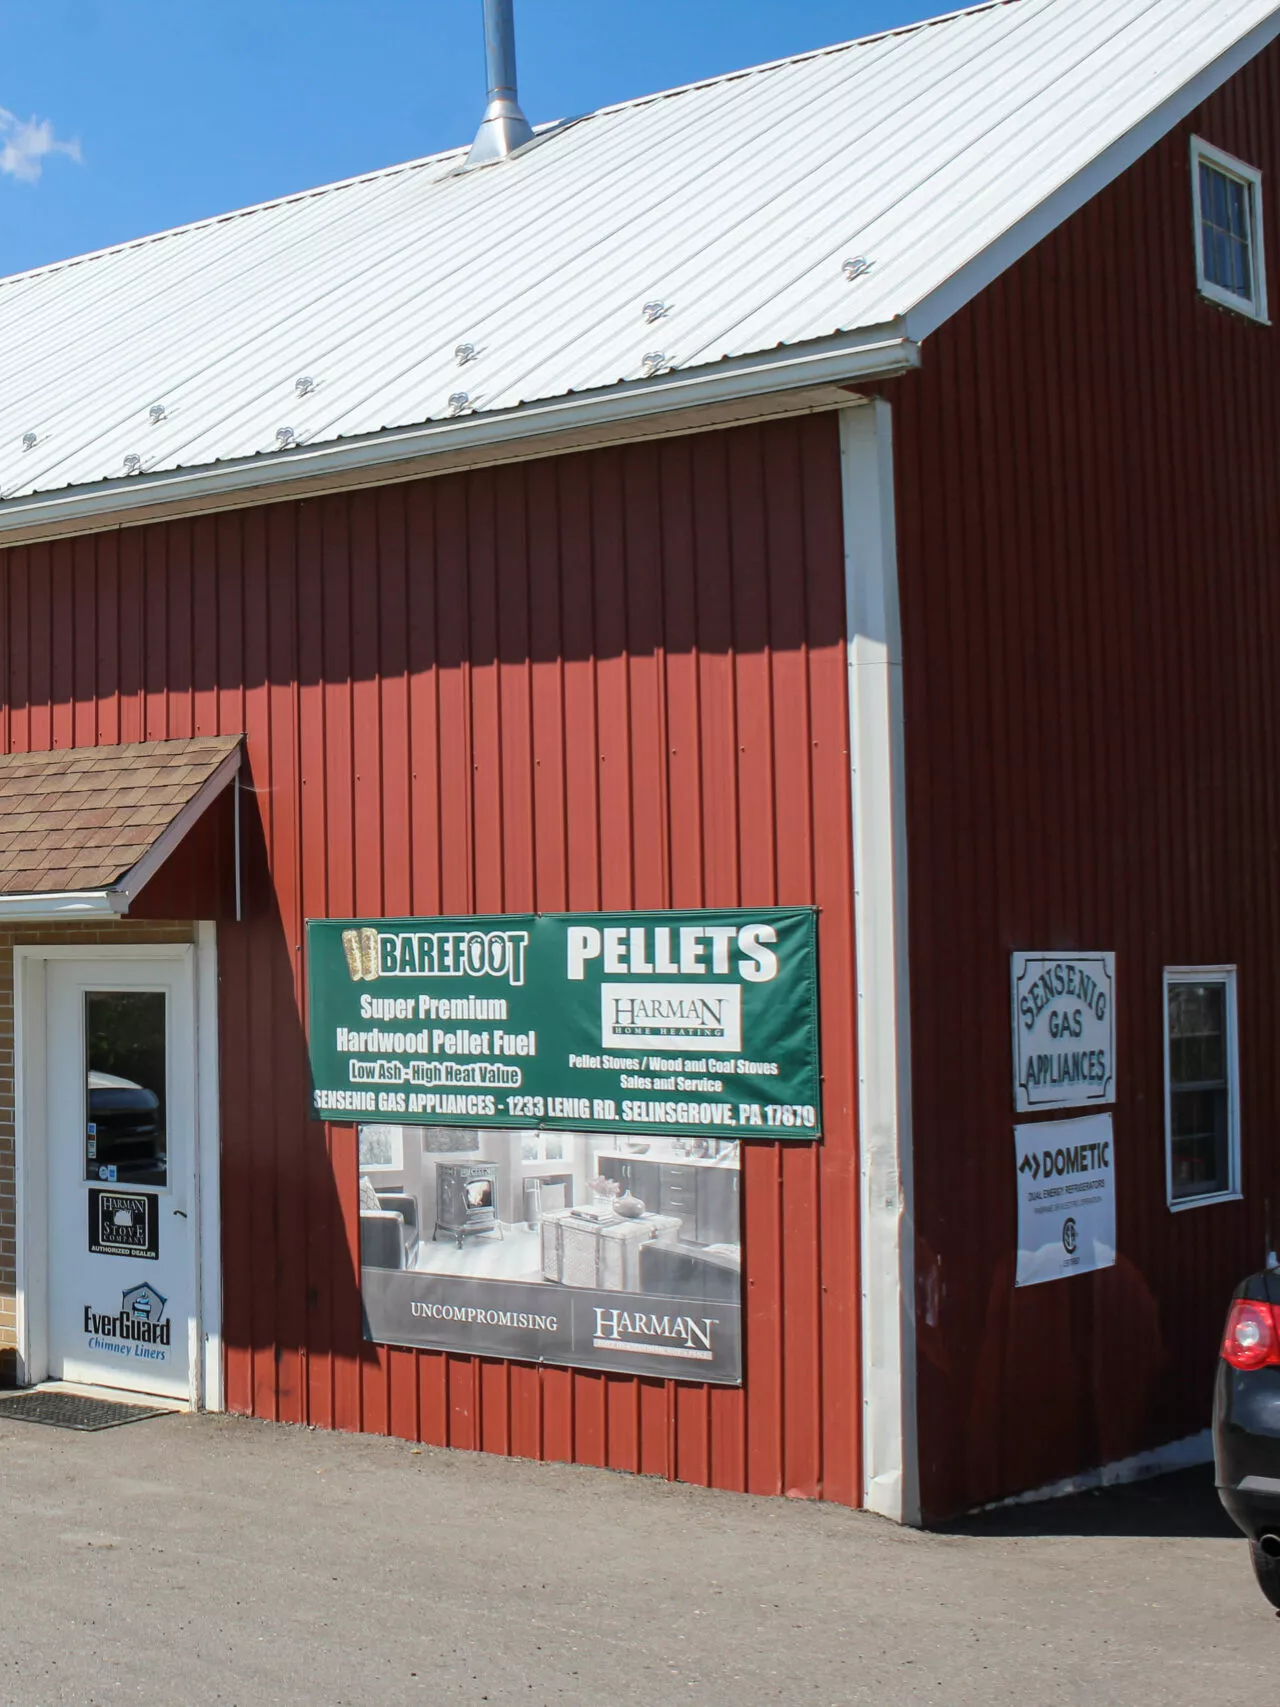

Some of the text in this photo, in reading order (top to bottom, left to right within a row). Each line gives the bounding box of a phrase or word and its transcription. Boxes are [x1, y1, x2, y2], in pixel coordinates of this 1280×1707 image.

[378, 931, 529, 985] BAREFOOT
[567, 924, 778, 982] PELLETS
[360, 994, 508, 1021] Super Premium
[1020, 964, 1106, 1030] SENSENIG
[612, 998, 724, 1025] HARMAN
[1049, 1009, 1082, 1038] GAS
[336, 1027, 536, 1056] Hardwood Pellet Fuel
[615, 1026, 722, 1037] HOME HEATING
[351, 1062, 377, 1080] Low
[378, 1063, 402, 1081] Ash
[412, 1063, 442, 1084] High
[444, 1065, 476, 1083] Heat
[479, 1066, 519, 1085] Value
[569, 1053, 602, 1068] Pellet
[602, 1055, 640, 1071] Stoves
[649, 1056, 683, 1072] Wood
[684, 1058, 706, 1073] and
[708, 1058, 735, 1074] Coal
[737, 1059, 779, 1075] Stoves
[1026, 1050, 1105, 1085] APPLIANCES
[620, 1075, 723, 1092] Sales and Service
[313, 1089, 376, 1111] SENSENIG
[378, 1092, 406, 1112] GAS
[408, 1093, 495, 1115] APPLIANCES
[506, 1096, 544, 1117] 1233
[547, 1097, 590, 1119] LENIG
[593, 1099, 619, 1120] RD.
[622, 1100, 737, 1126] SELINSGROVE,
[739, 1103, 764, 1125] PA
[764, 1104, 815, 1127] 17870
[1043, 1141, 1109, 1178] DOMETIC
[103, 1197, 144, 1213] HARMAN
[104, 1221, 144, 1238] STOVE
[104, 1234, 144, 1245] COMPANY
[91, 1245, 156, 1258] AUTHORIZED DEALER
[84, 1305, 170, 1346] EverGuard
[411, 1302, 558, 1332] UNCOMPROMISING
[593, 1307, 713, 1349] HARMAN
[88, 1337, 165, 1361] Chimney Liners
